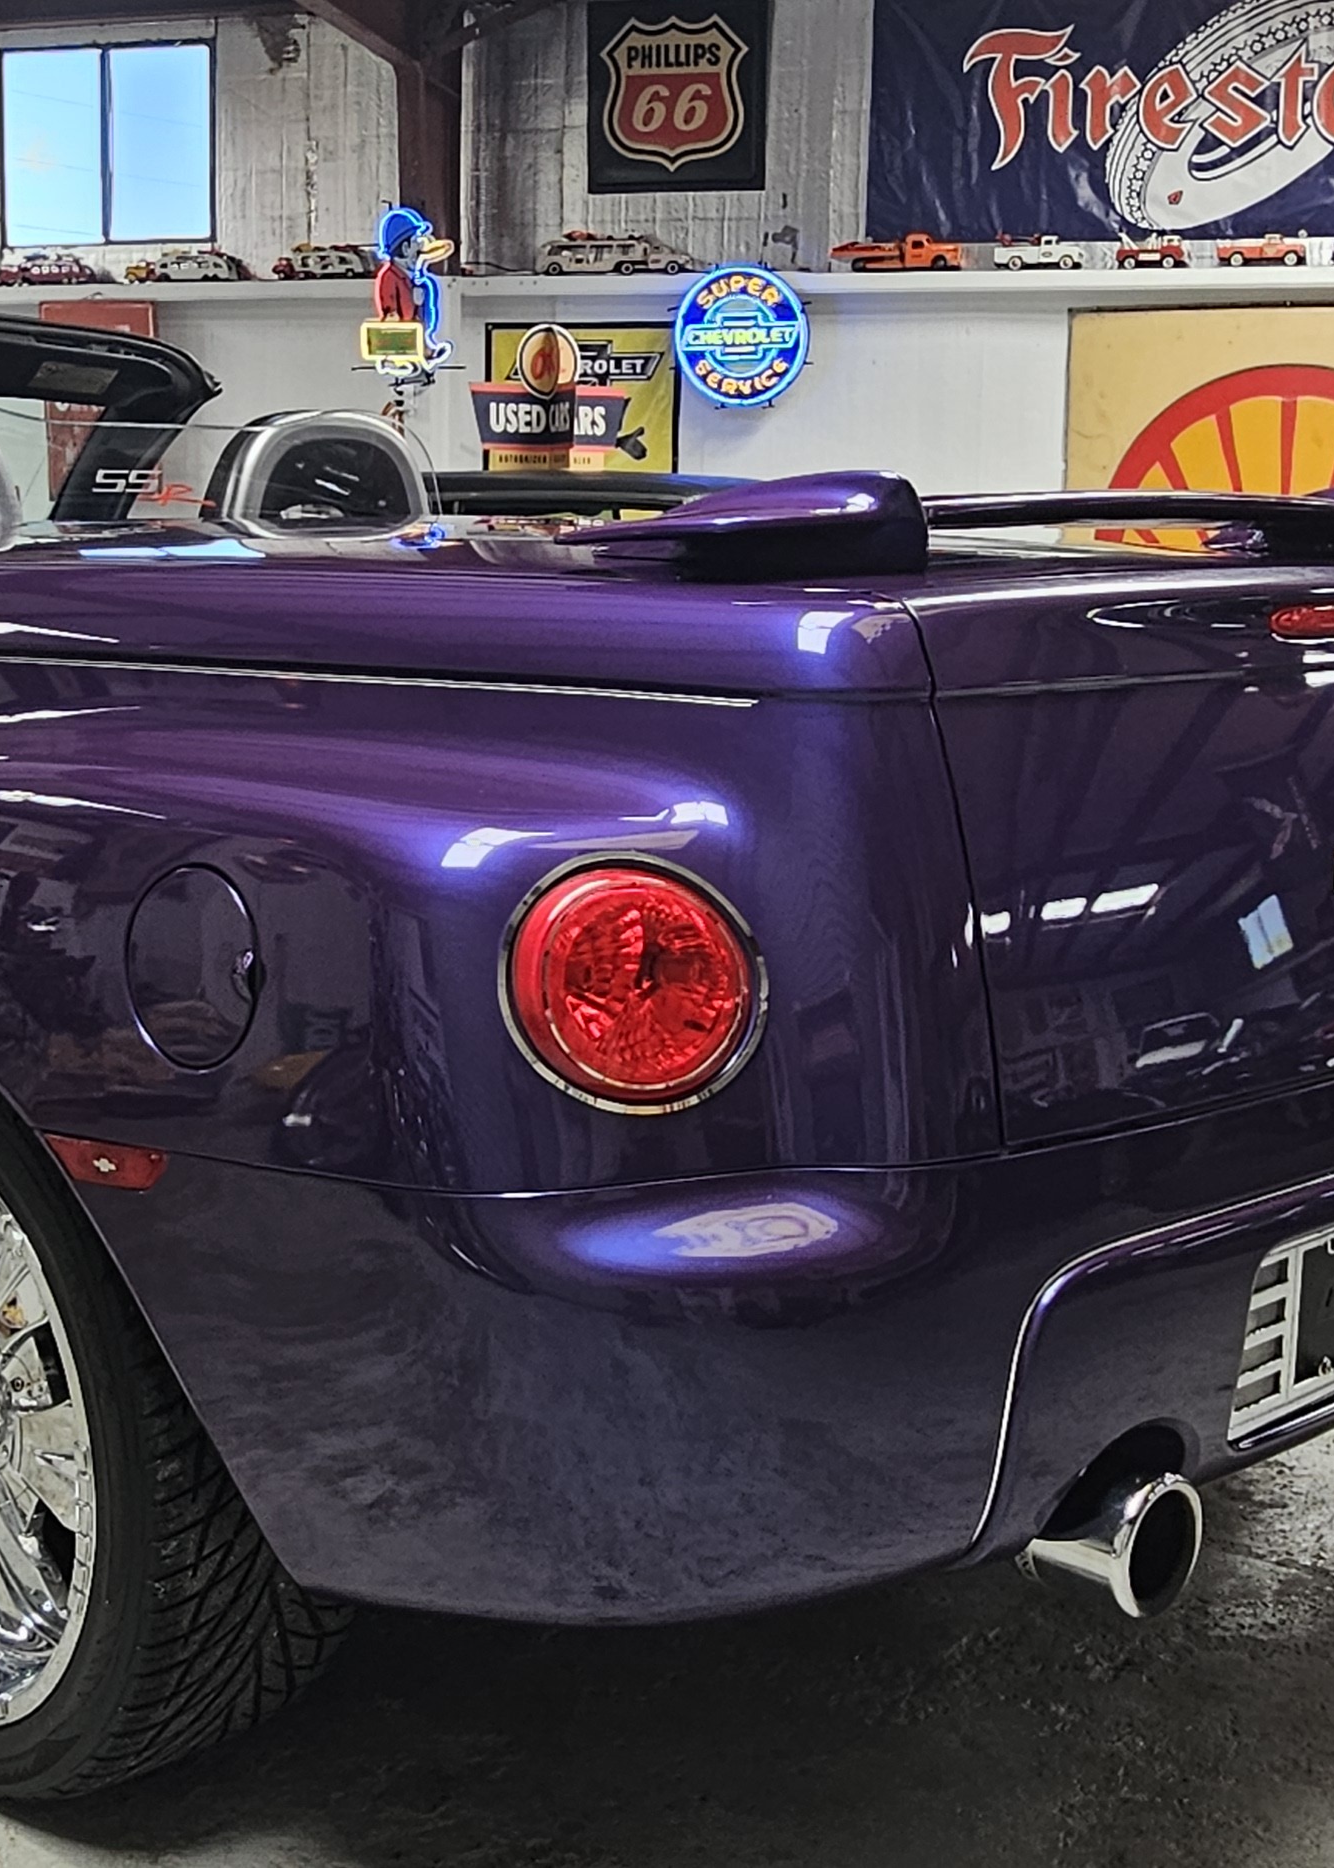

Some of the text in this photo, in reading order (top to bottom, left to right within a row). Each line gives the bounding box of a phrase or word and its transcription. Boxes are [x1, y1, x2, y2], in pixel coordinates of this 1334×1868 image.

[627, 43, 721, 69] PHILLIPS
[632, 83, 712, 132] 66
[696, 275, 781, 309] SUPER
[687, 328, 796, 346] CHEVROLET
[581, 358, 645, 374] ROLET
[695, 358, 789, 395] SERVICE
[489, 402, 547, 433] USED
